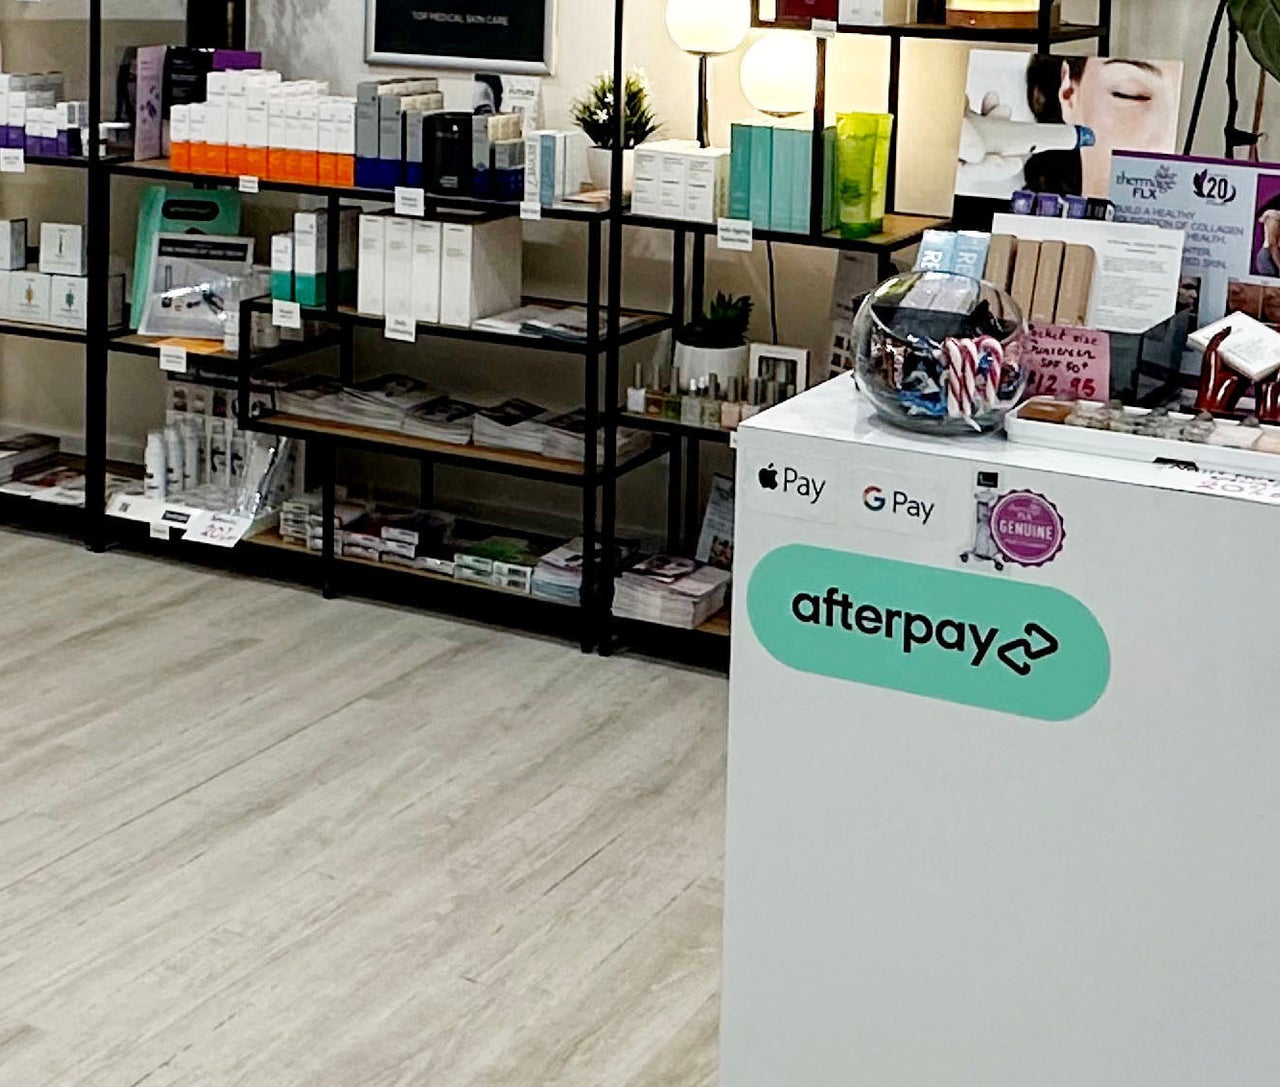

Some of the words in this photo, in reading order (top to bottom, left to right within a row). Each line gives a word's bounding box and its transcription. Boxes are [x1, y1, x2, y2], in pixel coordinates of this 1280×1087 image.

[429, 12, 464, 23] MEDICAL
[485, 15, 509, 26] CARE
[1132, 187, 1157, 200] FLX
[1206, 176, 1228, 200] 20
[1152, 208, 1196, 219] HEALTHY
[1191, 222, 1244, 235] COLLAGEN
[784, 467, 826, 504] Pay
[893, 491, 935, 524] Pay
[999, 519, 1053, 541] GENUINE
[791, 586, 1000, 667] afterpay
